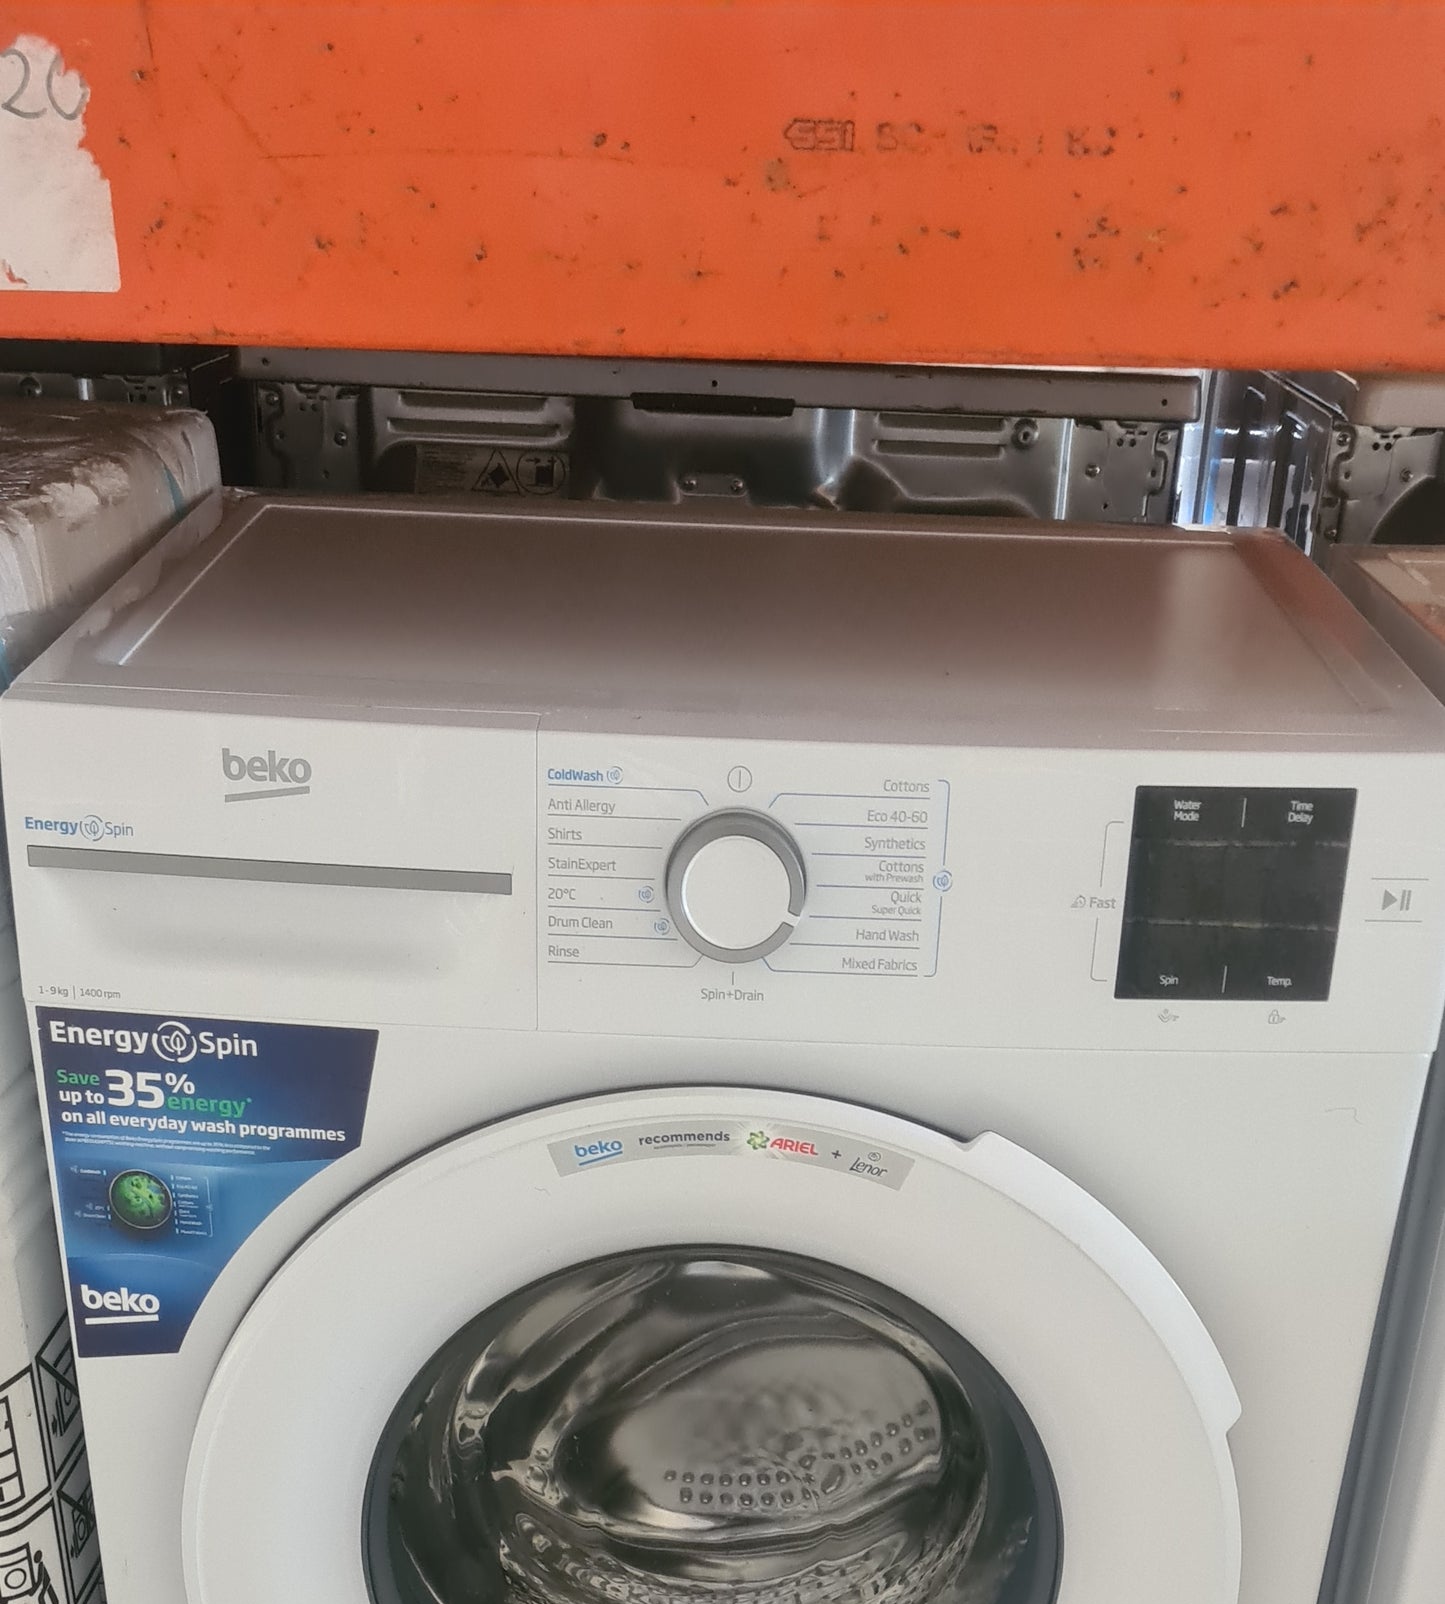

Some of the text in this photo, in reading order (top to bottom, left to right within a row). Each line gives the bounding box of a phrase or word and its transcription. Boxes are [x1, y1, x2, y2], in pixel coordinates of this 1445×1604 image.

[221, 747, 313, 785] beko
[547, 768, 604, 781] ColdWash
[883, 779, 930, 792] Cottons
[547, 798, 616, 815] Anti Allergy
[1173, 800, 1202, 810] Water
[1291, 800, 1314, 812] Time
[867, 809, 928, 823] Eco 40-60
[1173, 811, 1200, 821] Mode
[1287, 812, 1313, 825] Delay
[24, 815, 134, 838] Energy Spin
[547, 827, 583, 840] Shirts
[864, 836, 926, 852] Synthetics
[548, 857, 616, 873] StainExpert
[878, 860, 925, 873] Cottons
[865, 873, 924, 883] with Prewash
[890, 890, 922, 905] Quick
[1089, 896, 1116, 909] Fast
[871, 904, 921, 916] Super Quick
[548, 915, 613, 930] Drum Clean
[855, 929, 920, 942] Hand Wash
[548, 945, 580, 958] Rinse
[841, 957, 918, 972] Mixed Fabrics
[1159, 975, 1179, 987] Spin
[1267, 976, 1293, 988] Temp.
[57, 986, 69, 998] kg
[80, 988, 103, 998] 1400
[103, 990, 121, 1000] rpm
[700, 987, 765, 1002] Spin+Drain
[49, 1020, 259, 1060] Energy Spin
[56, 1069, 101, 1087] Save
[105, 1069, 196, 1110] 35%
[59, 1090, 105, 1106] up to
[61, 1111, 347, 1143] on all everyday wash programmes
[574, 1139, 623, 1158] beko
[638, 1131, 730, 1147] recommends
[769, 1138, 819, 1156] ARIEL
[849, 1156, 888, 1177] Lenor
[80, 1284, 161, 1315] beko
